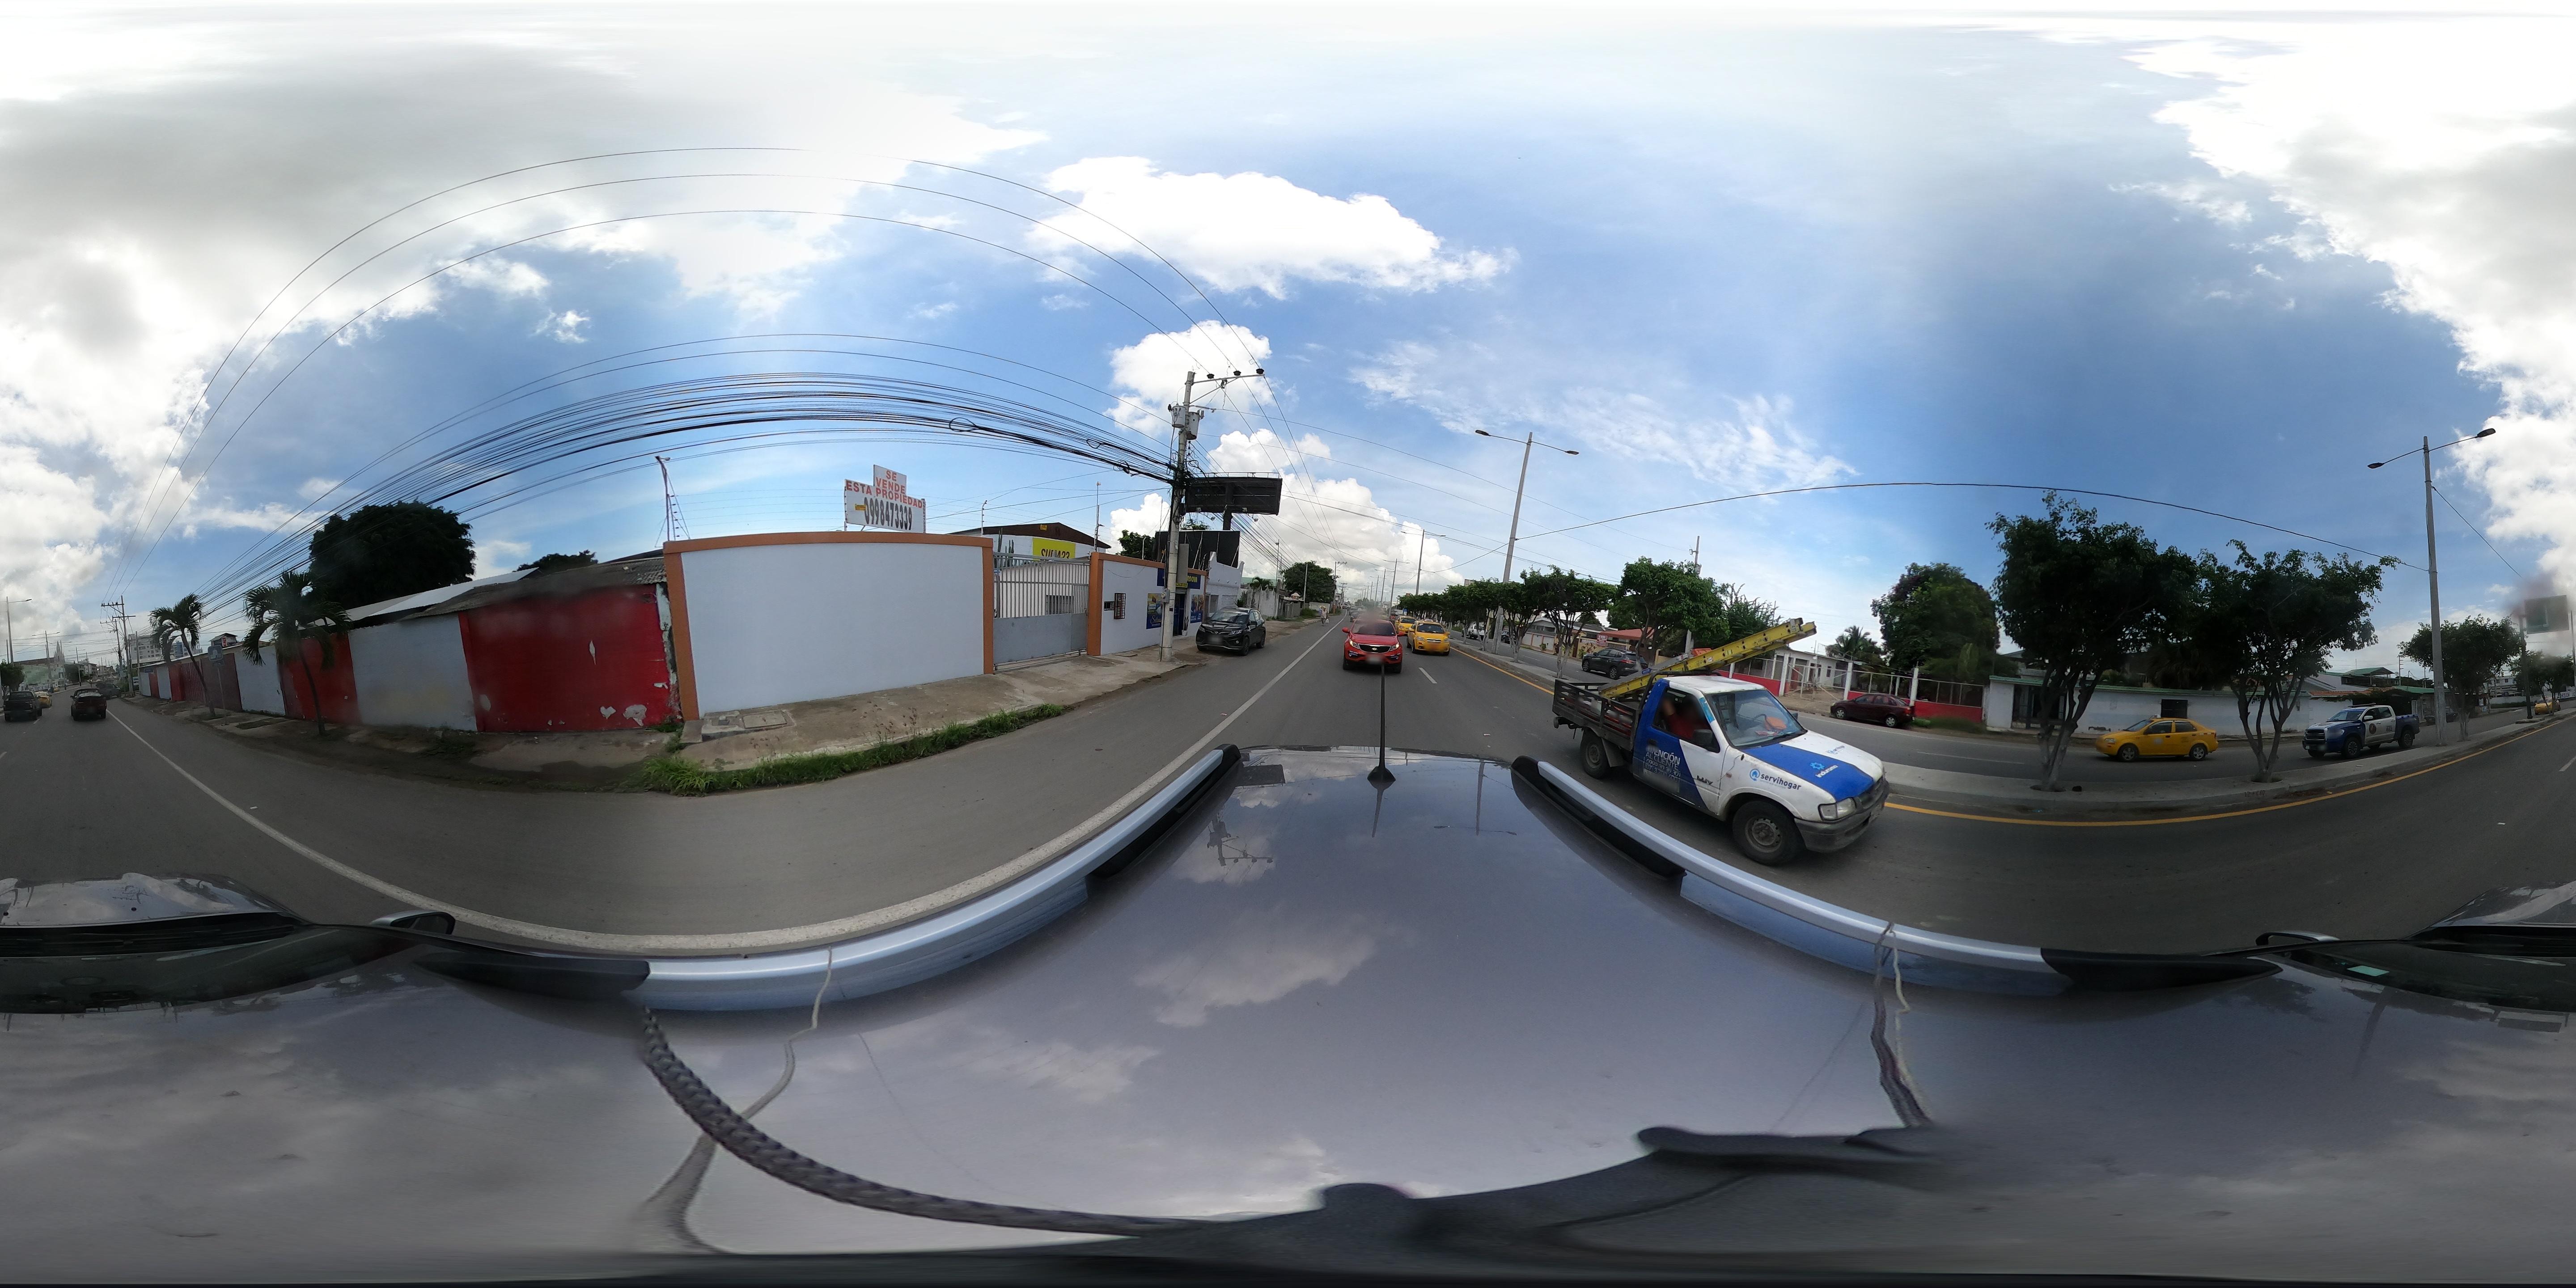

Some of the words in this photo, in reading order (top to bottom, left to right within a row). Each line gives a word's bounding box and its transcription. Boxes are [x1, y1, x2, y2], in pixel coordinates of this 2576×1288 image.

[886, 470, 897, 482] SE
[846, 480, 872, 495] ESTA
[876, 487, 923, 508] PROPIEDAD
[876, 477, 905, 494] VENDE
[864, 497, 912, 530] 0998473339
[1646, 746, 1681, 765] ENCIÓN
[1761, 774, 1801, 790] servihogar
